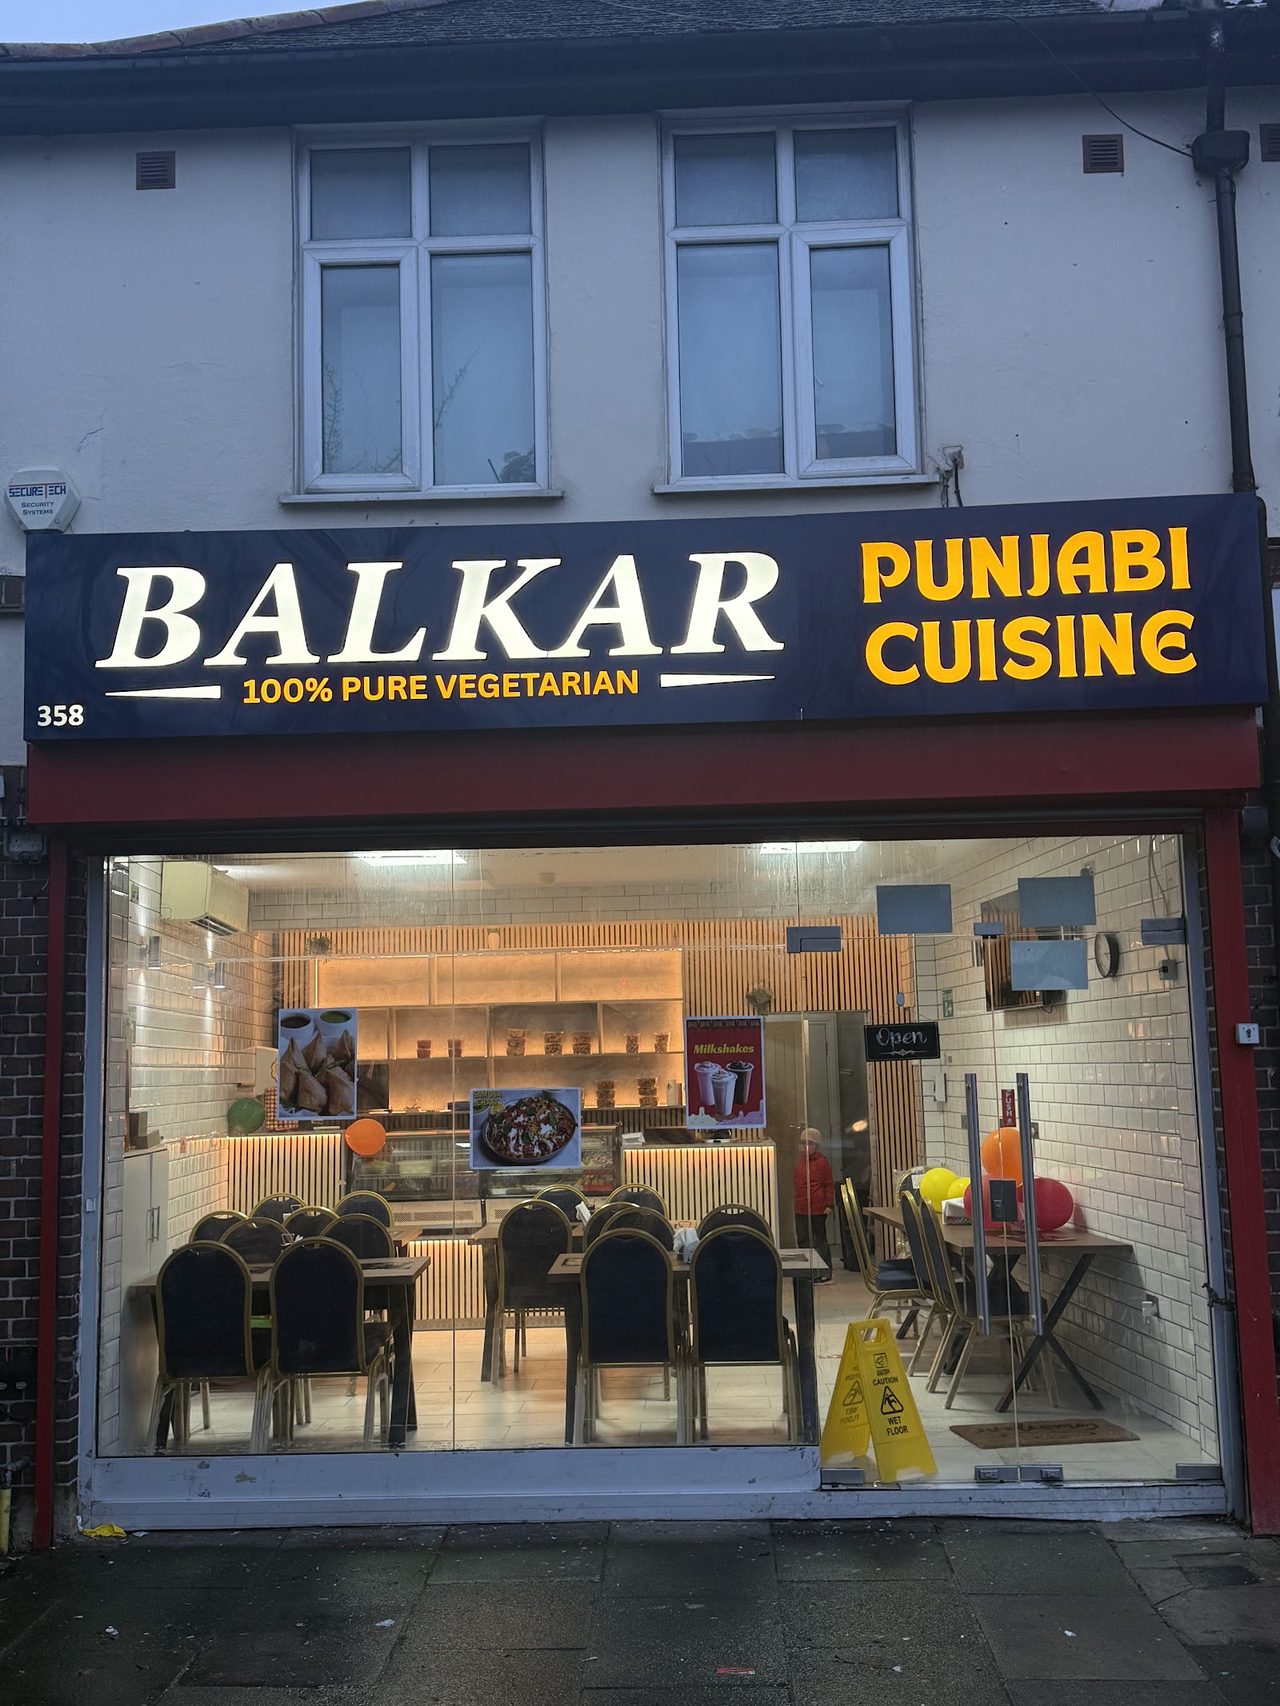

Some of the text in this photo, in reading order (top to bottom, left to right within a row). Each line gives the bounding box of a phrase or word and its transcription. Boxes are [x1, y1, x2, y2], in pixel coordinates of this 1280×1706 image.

[861, 527, 1191, 604] PUNJABI
[95, 552, 785, 668] BALKAR
[866, 610, 1197, 686] CUISINE
[243, 670, 639, 704] 100% PURE VEGETARIAN
[37, 705, 84, 727] 358
[693, 1043, 755, 1054] Milkshakes
[876, 1027, 928, 1051] Open
[872, 1376, 899, 1386] CAUTION
[886, 1426, 909, 1436] FLOOR
[887, 1416, 902, 1425] WET
